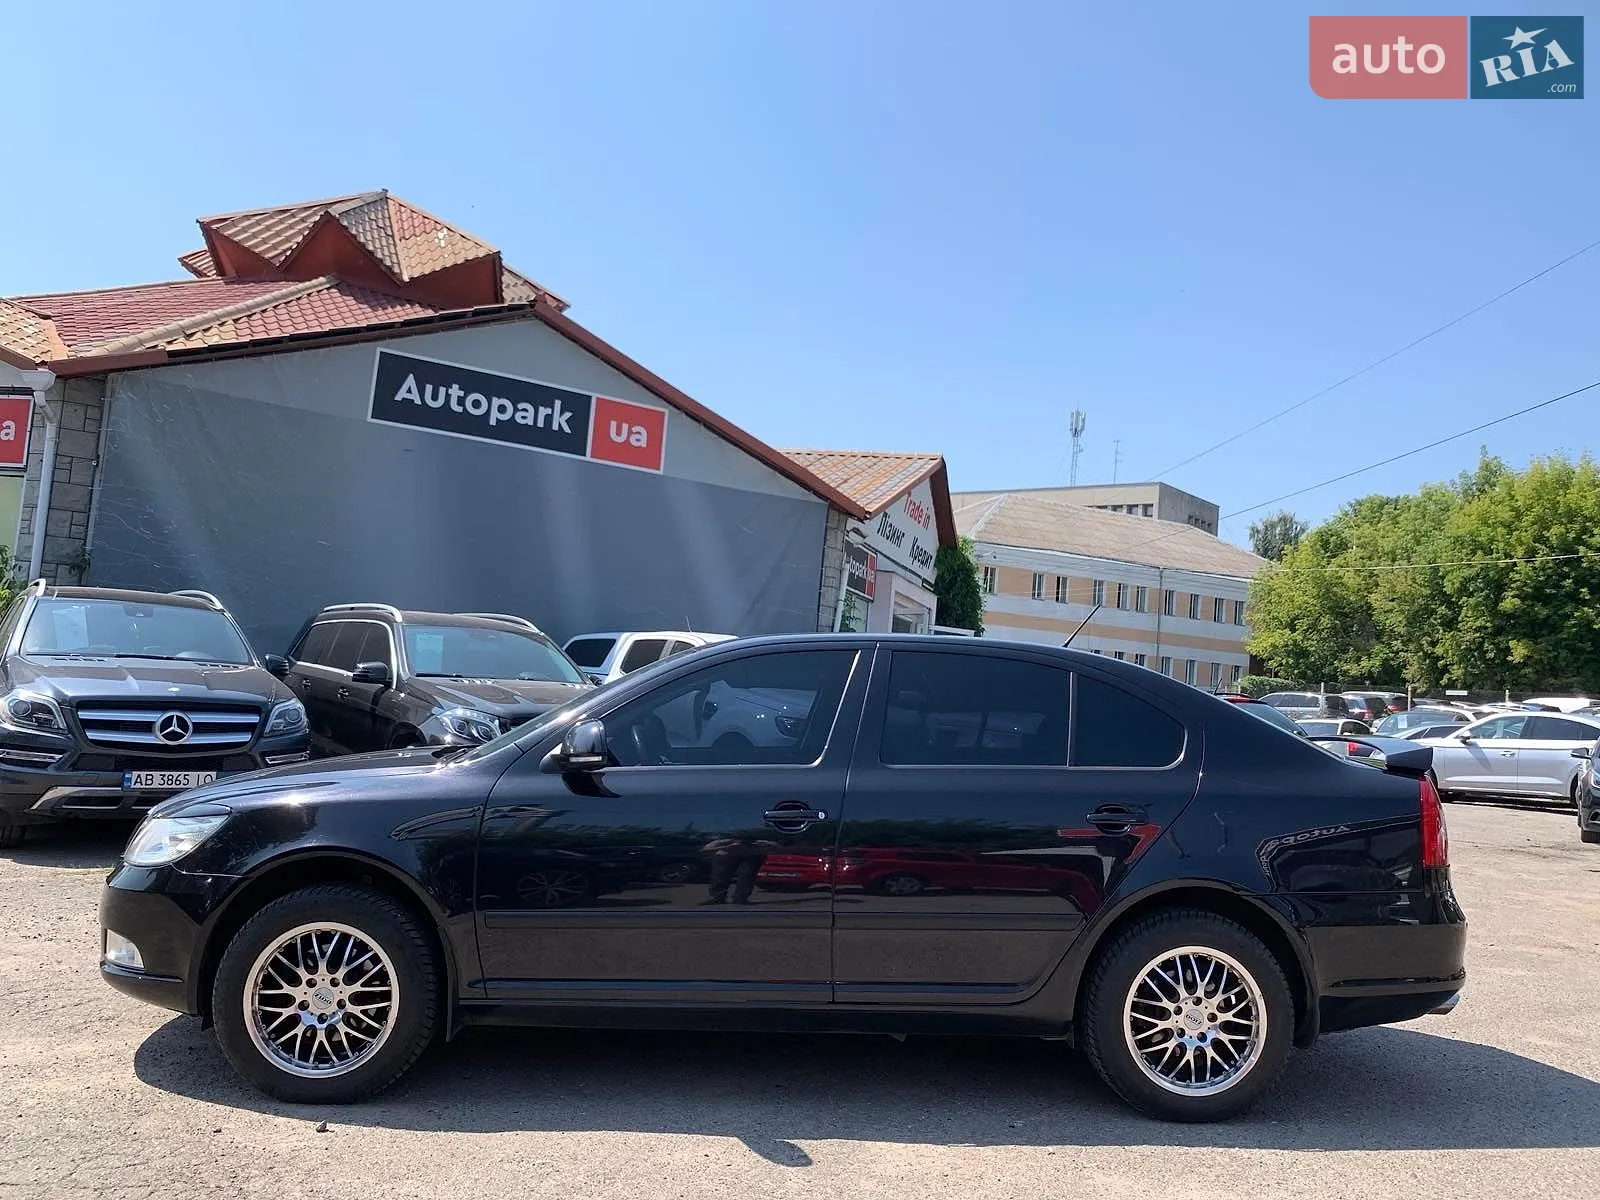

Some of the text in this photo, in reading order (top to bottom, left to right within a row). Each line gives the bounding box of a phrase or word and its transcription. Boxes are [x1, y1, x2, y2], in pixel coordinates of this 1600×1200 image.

[394, 373, 647, 448] Autopark ua
[903, 490, 931, 530] Trade in
[877, 511, 933, 569] Лізинг Кредит
[133, 773, 154, 786] AB
[158, 773, 190, 786] 3865
